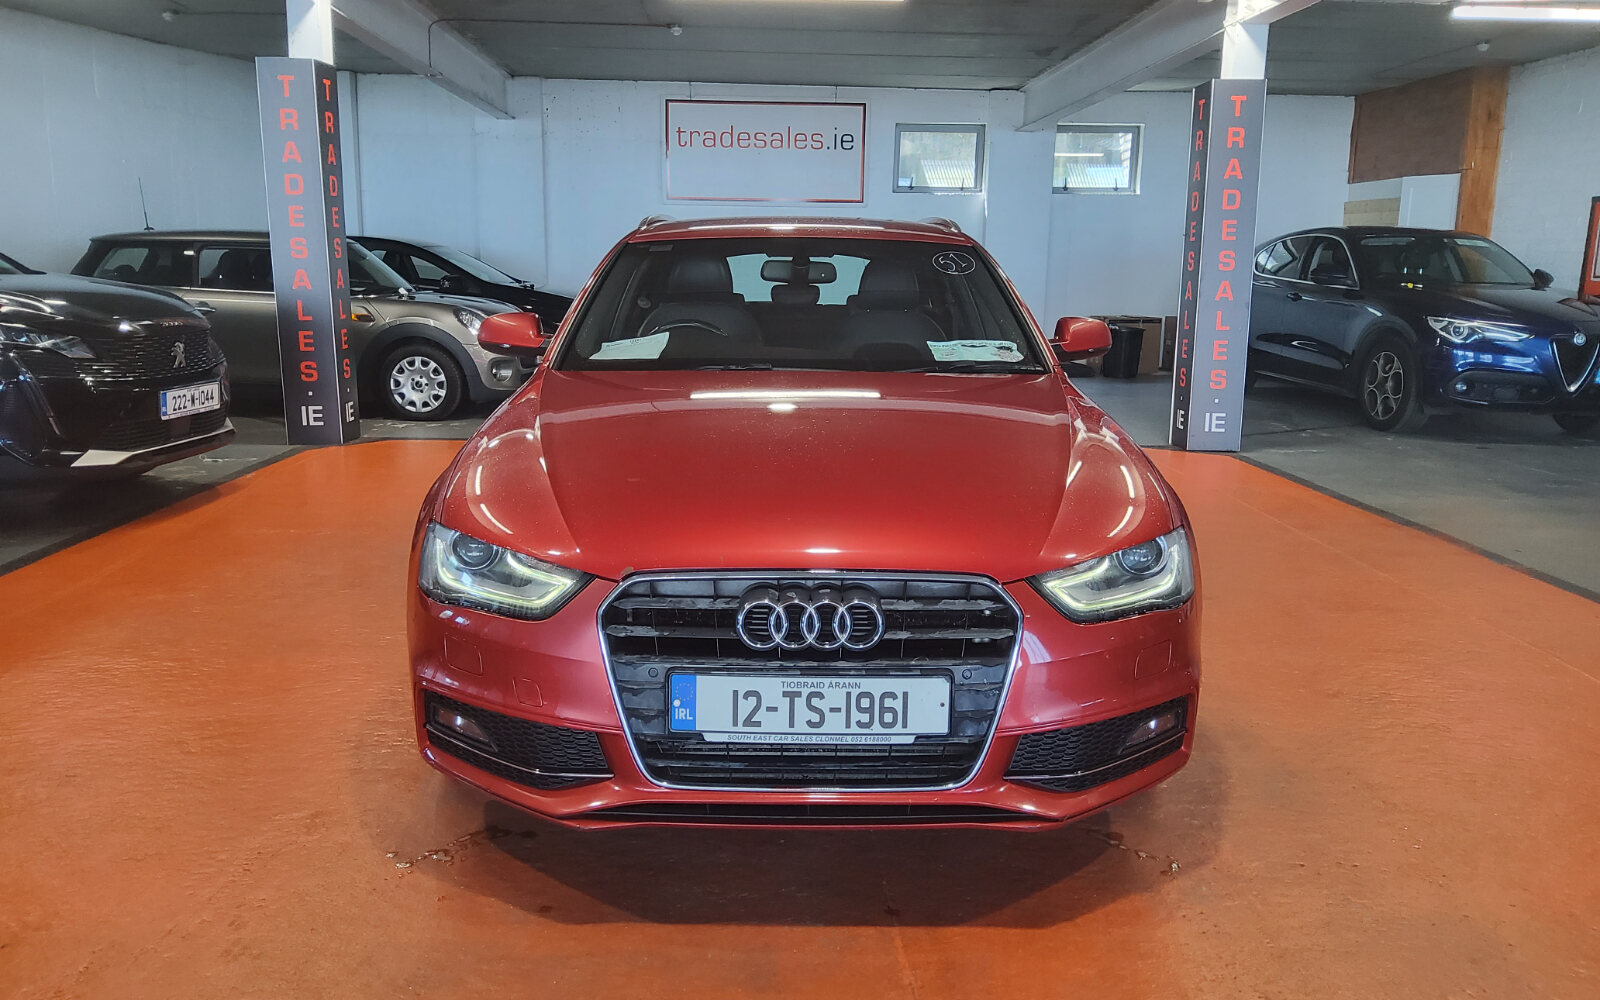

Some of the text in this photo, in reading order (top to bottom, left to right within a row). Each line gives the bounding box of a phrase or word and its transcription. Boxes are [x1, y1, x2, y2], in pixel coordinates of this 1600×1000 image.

[675, 125, 855, 151] tradesales.ie
[781, 680, 861, 689] TIOBRAID ÁRANN
[675, 708, 693, 720] IRL
[732, 689, 909, 729] 12-TS-1961
[774, 734, 788, 742] CAR
[790, 734, 813, 742] SALES
[815, 735, 849, 743] CLONMEL
